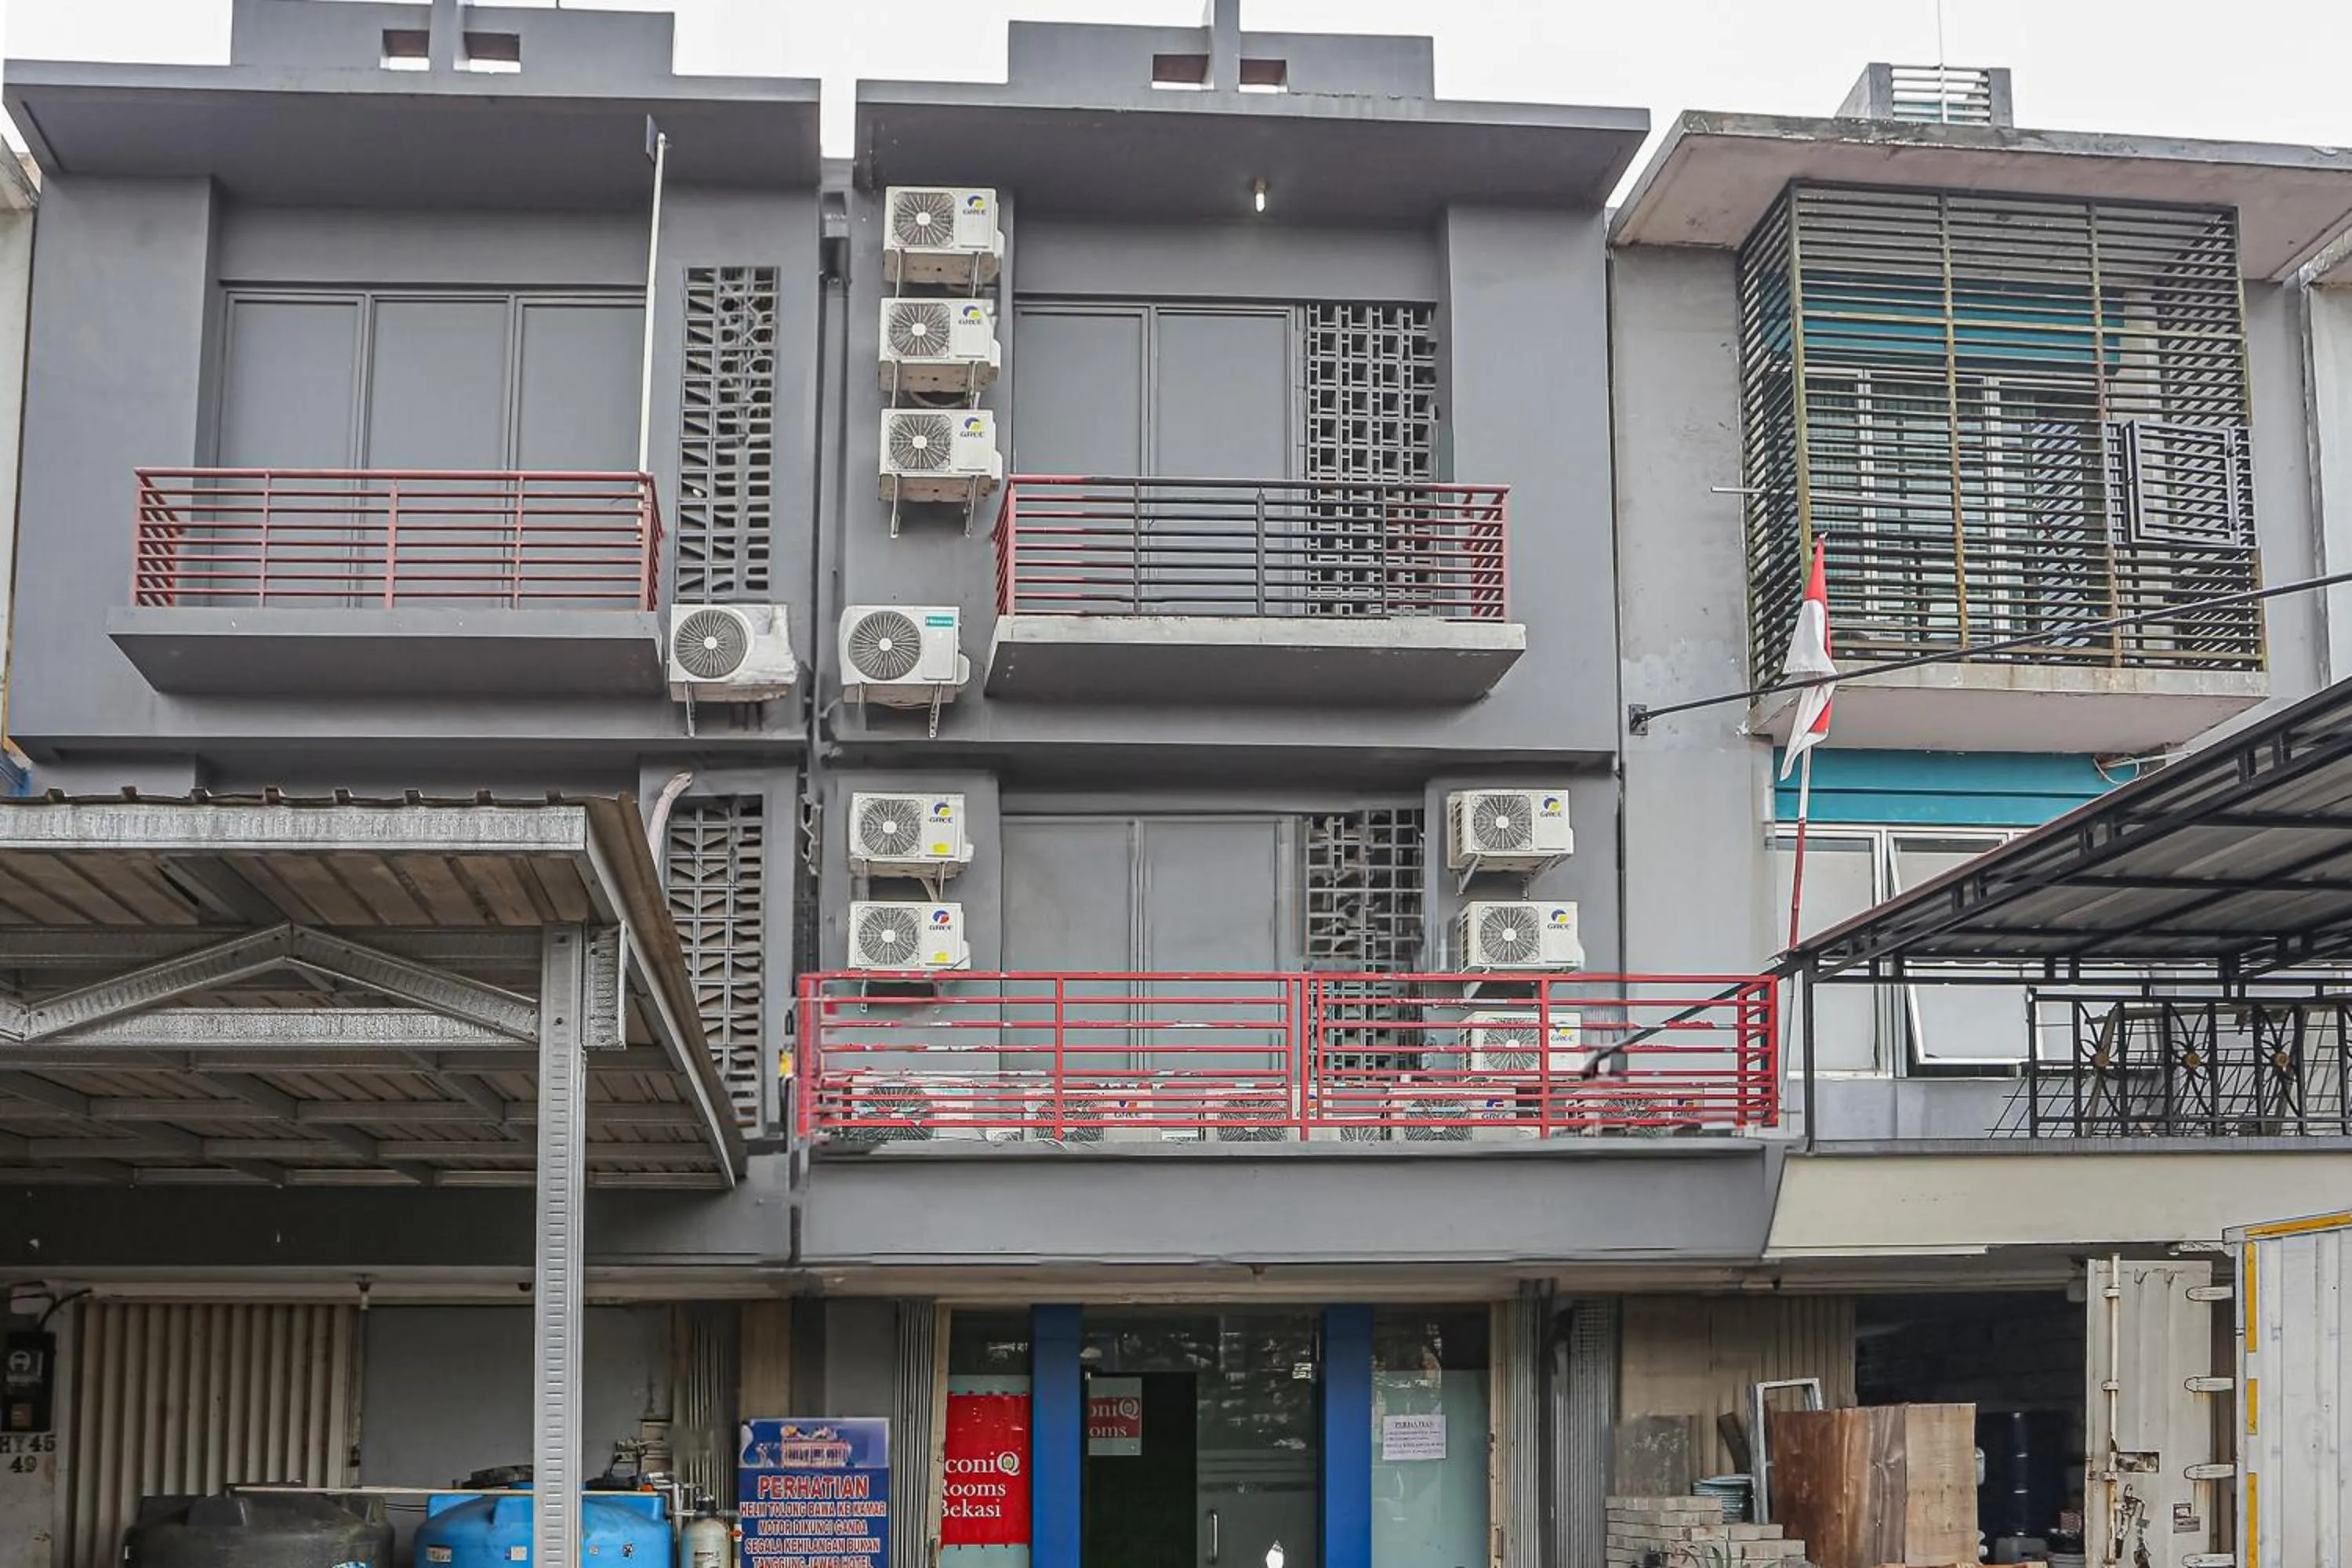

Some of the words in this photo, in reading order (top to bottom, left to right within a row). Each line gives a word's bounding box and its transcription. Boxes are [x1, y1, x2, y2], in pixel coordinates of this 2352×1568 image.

[943, 1450, 1020, 1476] coniQ
[757, 1475, 869, 1499] PERHATIAN
[740, 1502, 767, 1516] HELM
[768, 1502, 806, 1516] TOLONG
[808, 1502, 836, 1516] BAWA
[837, 1502, 851, 1516] KE
[853, 1502, 887, 1516] KAMAR
[758, 1519, 792, 1535] MOTOR
[793, 1519, 833, 1535] DIKUNCI
[834, 1519, 868, 1535] GANDA
[745, 1538, 782, 1554] SEGALA
[784, 1538, 845, 1554] KEHILANGAN
[847, 1538, 880, 1554] BUKAN
[753, 1556, 806, 1568] TANGGUNG
